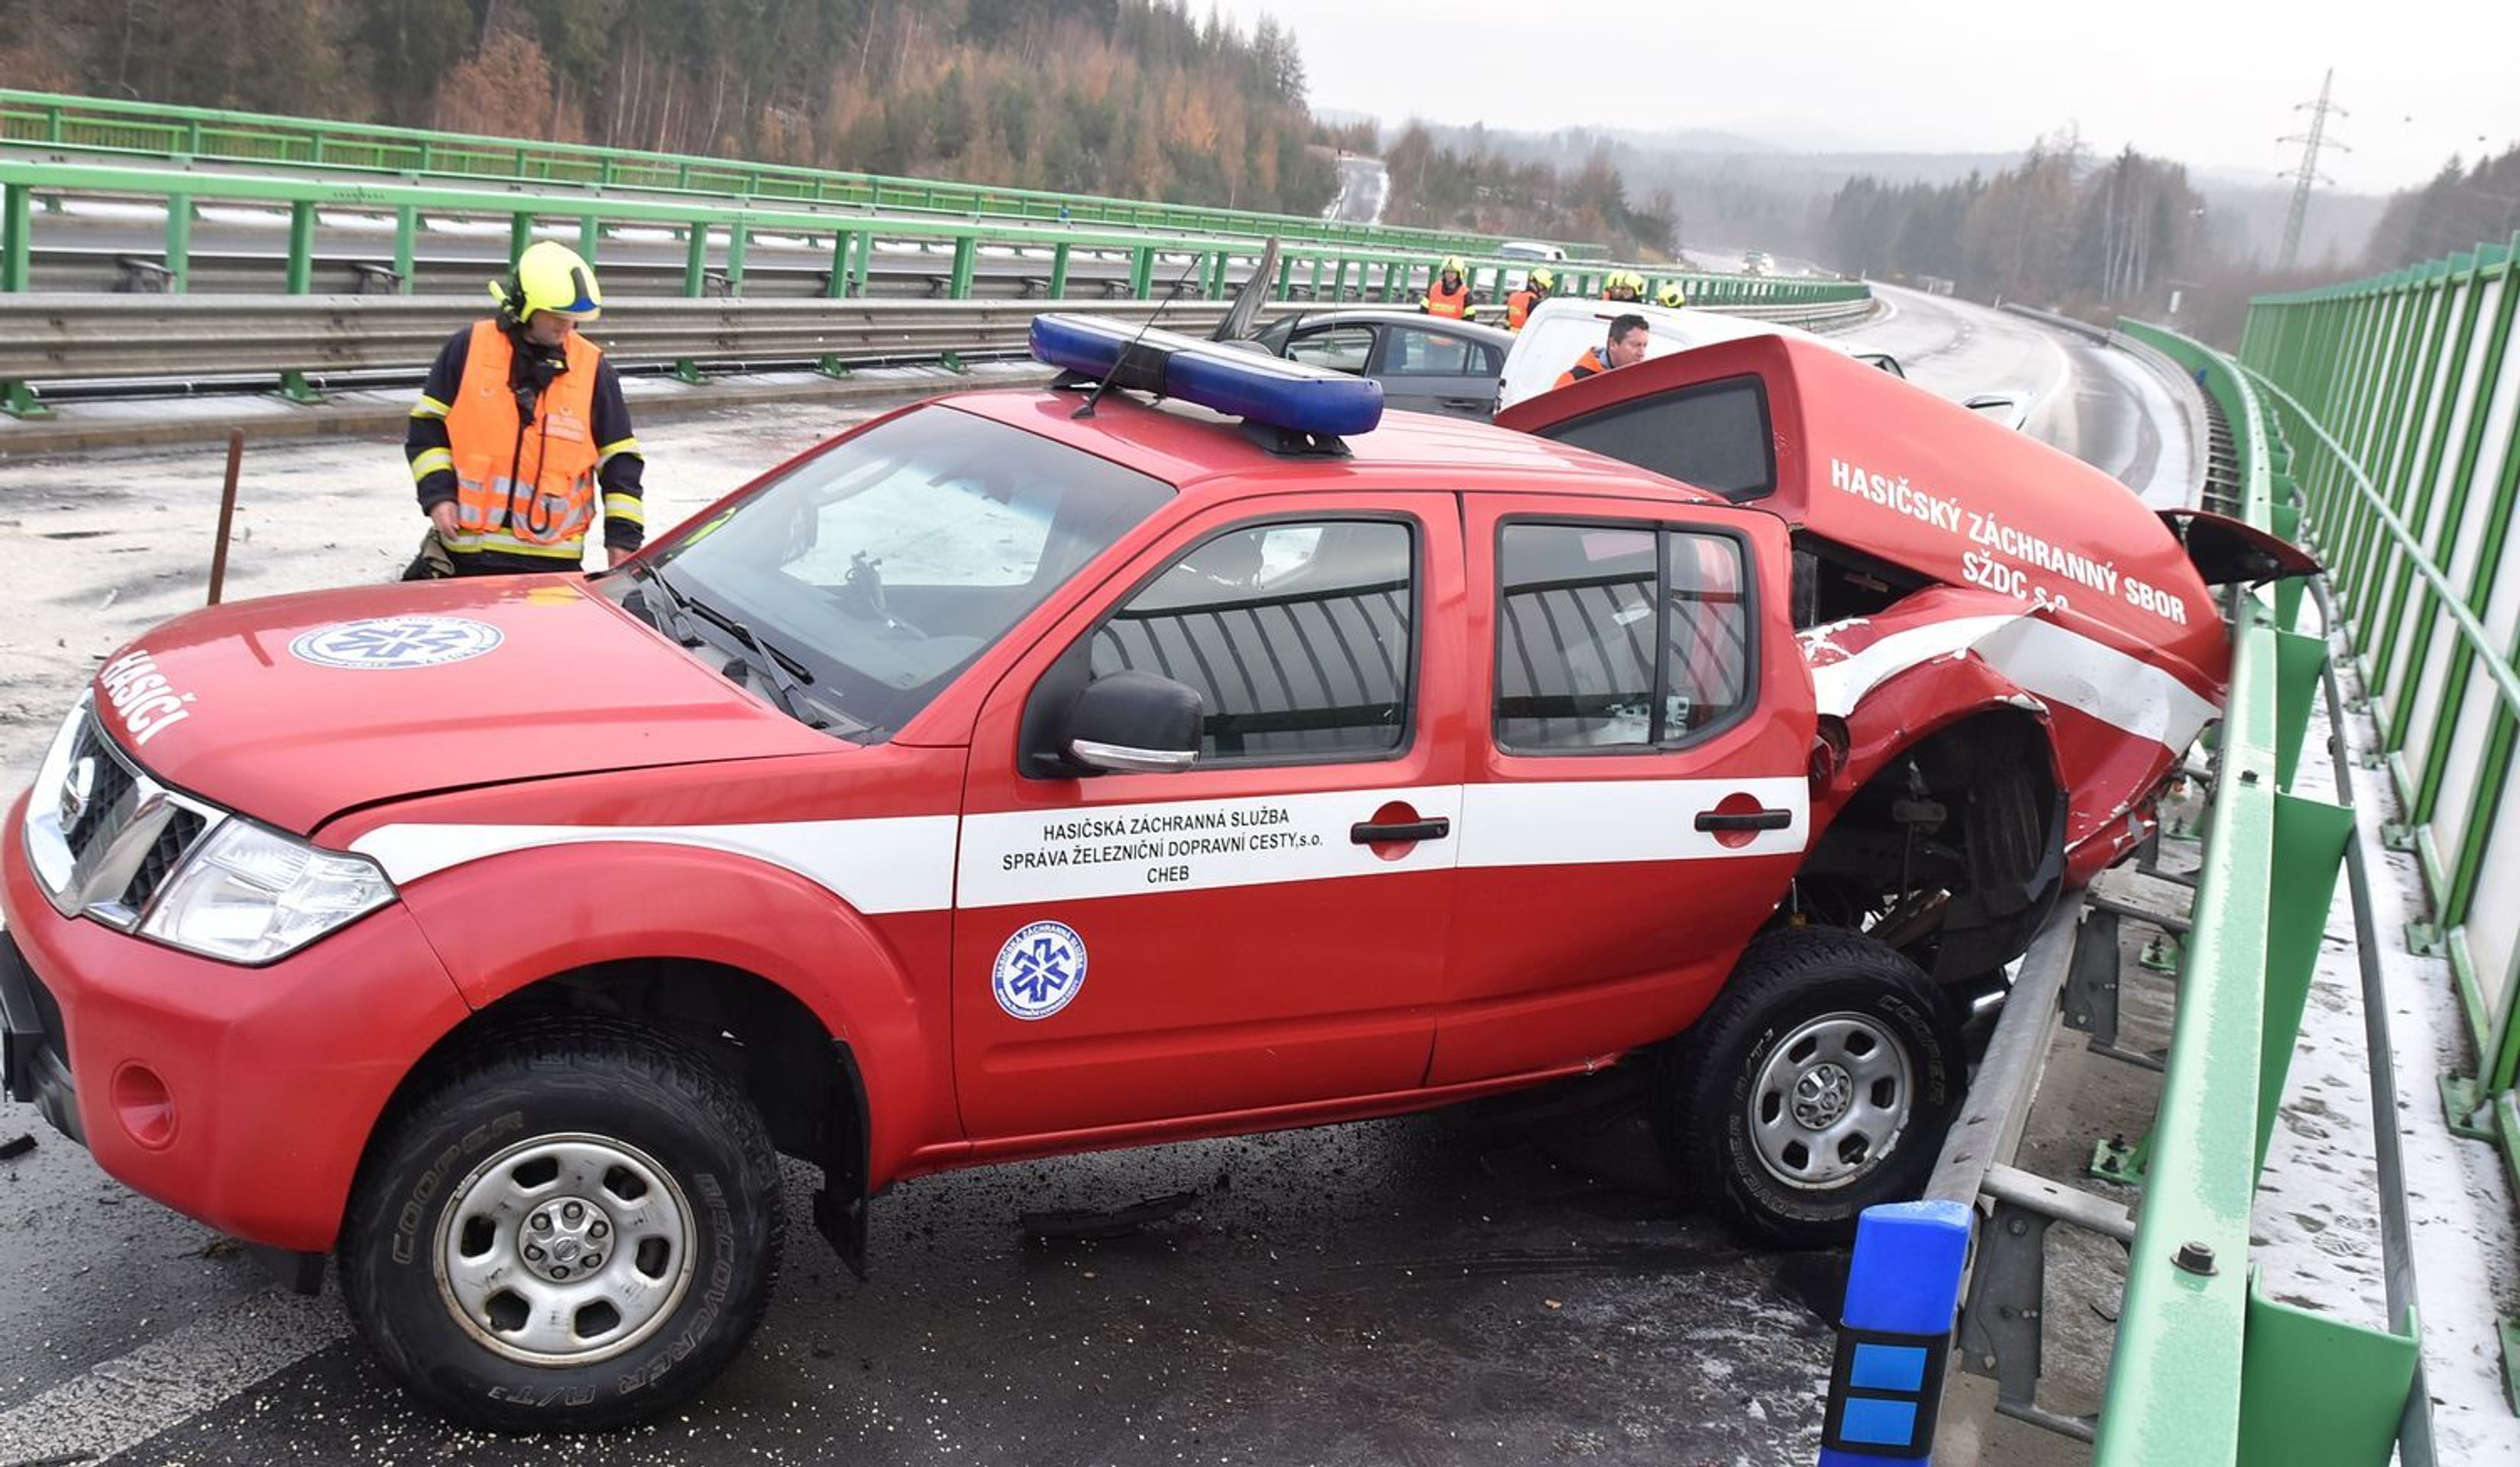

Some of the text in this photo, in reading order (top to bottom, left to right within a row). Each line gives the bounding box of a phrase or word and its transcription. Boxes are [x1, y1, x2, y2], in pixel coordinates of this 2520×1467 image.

[1831, 458, 2187, 626] HASIČSKÝ ZÁCHRANNÝ SBOR
[1962, 551, 2027, 601] SŽDC
[99, 649, 198, 746] HASIČI
[1003, 846, 1068, 871] SPRÁVA
[1072, 838, 1164, 865] ŽELEZNIČNÍ
[1168, 831, 1246, 857] DOPRAVNÍ
[1043, 805, 1289, 841] HASIČSKÁ ZÁCHRANNÁ SLUŽBA
[1147, 866, 1190, 884] CHEB
[393, 1110, 523, 1265] COOPER
[617, 1173, 736, 1395] DISCOVERER
